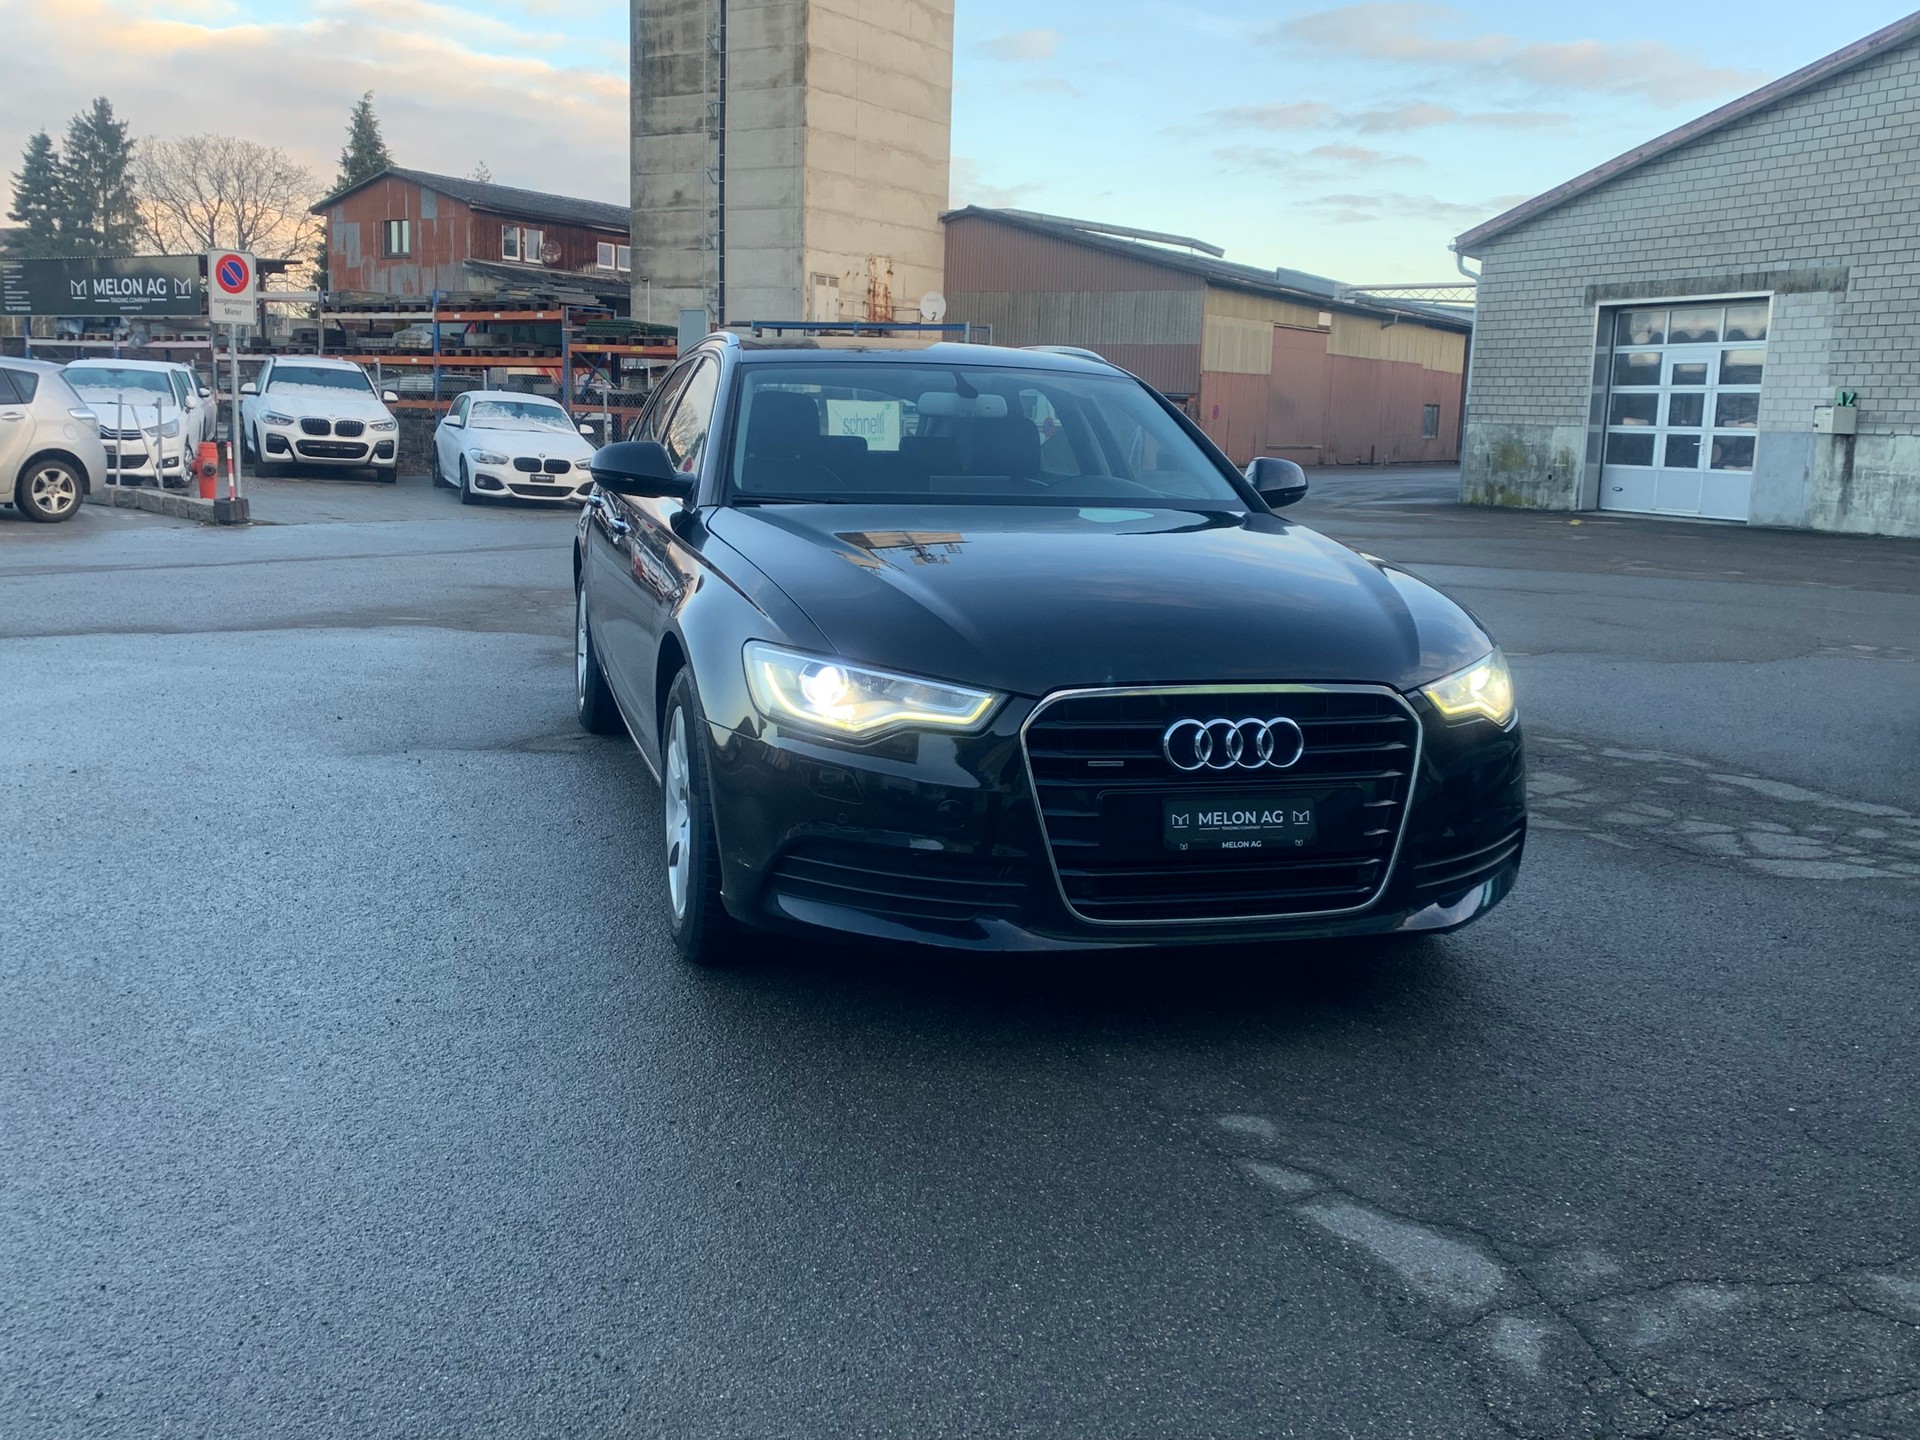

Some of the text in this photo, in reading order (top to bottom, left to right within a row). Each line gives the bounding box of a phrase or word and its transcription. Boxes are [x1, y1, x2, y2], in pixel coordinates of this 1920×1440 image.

[93, 278, 143, 296] MELON
[146, 277, 167, 295] AG
[1198, 811, 1257, 825] MELON
[1260, 810, 1284, 824] AG
[1221, 840, 1262, 849] MELON AG
